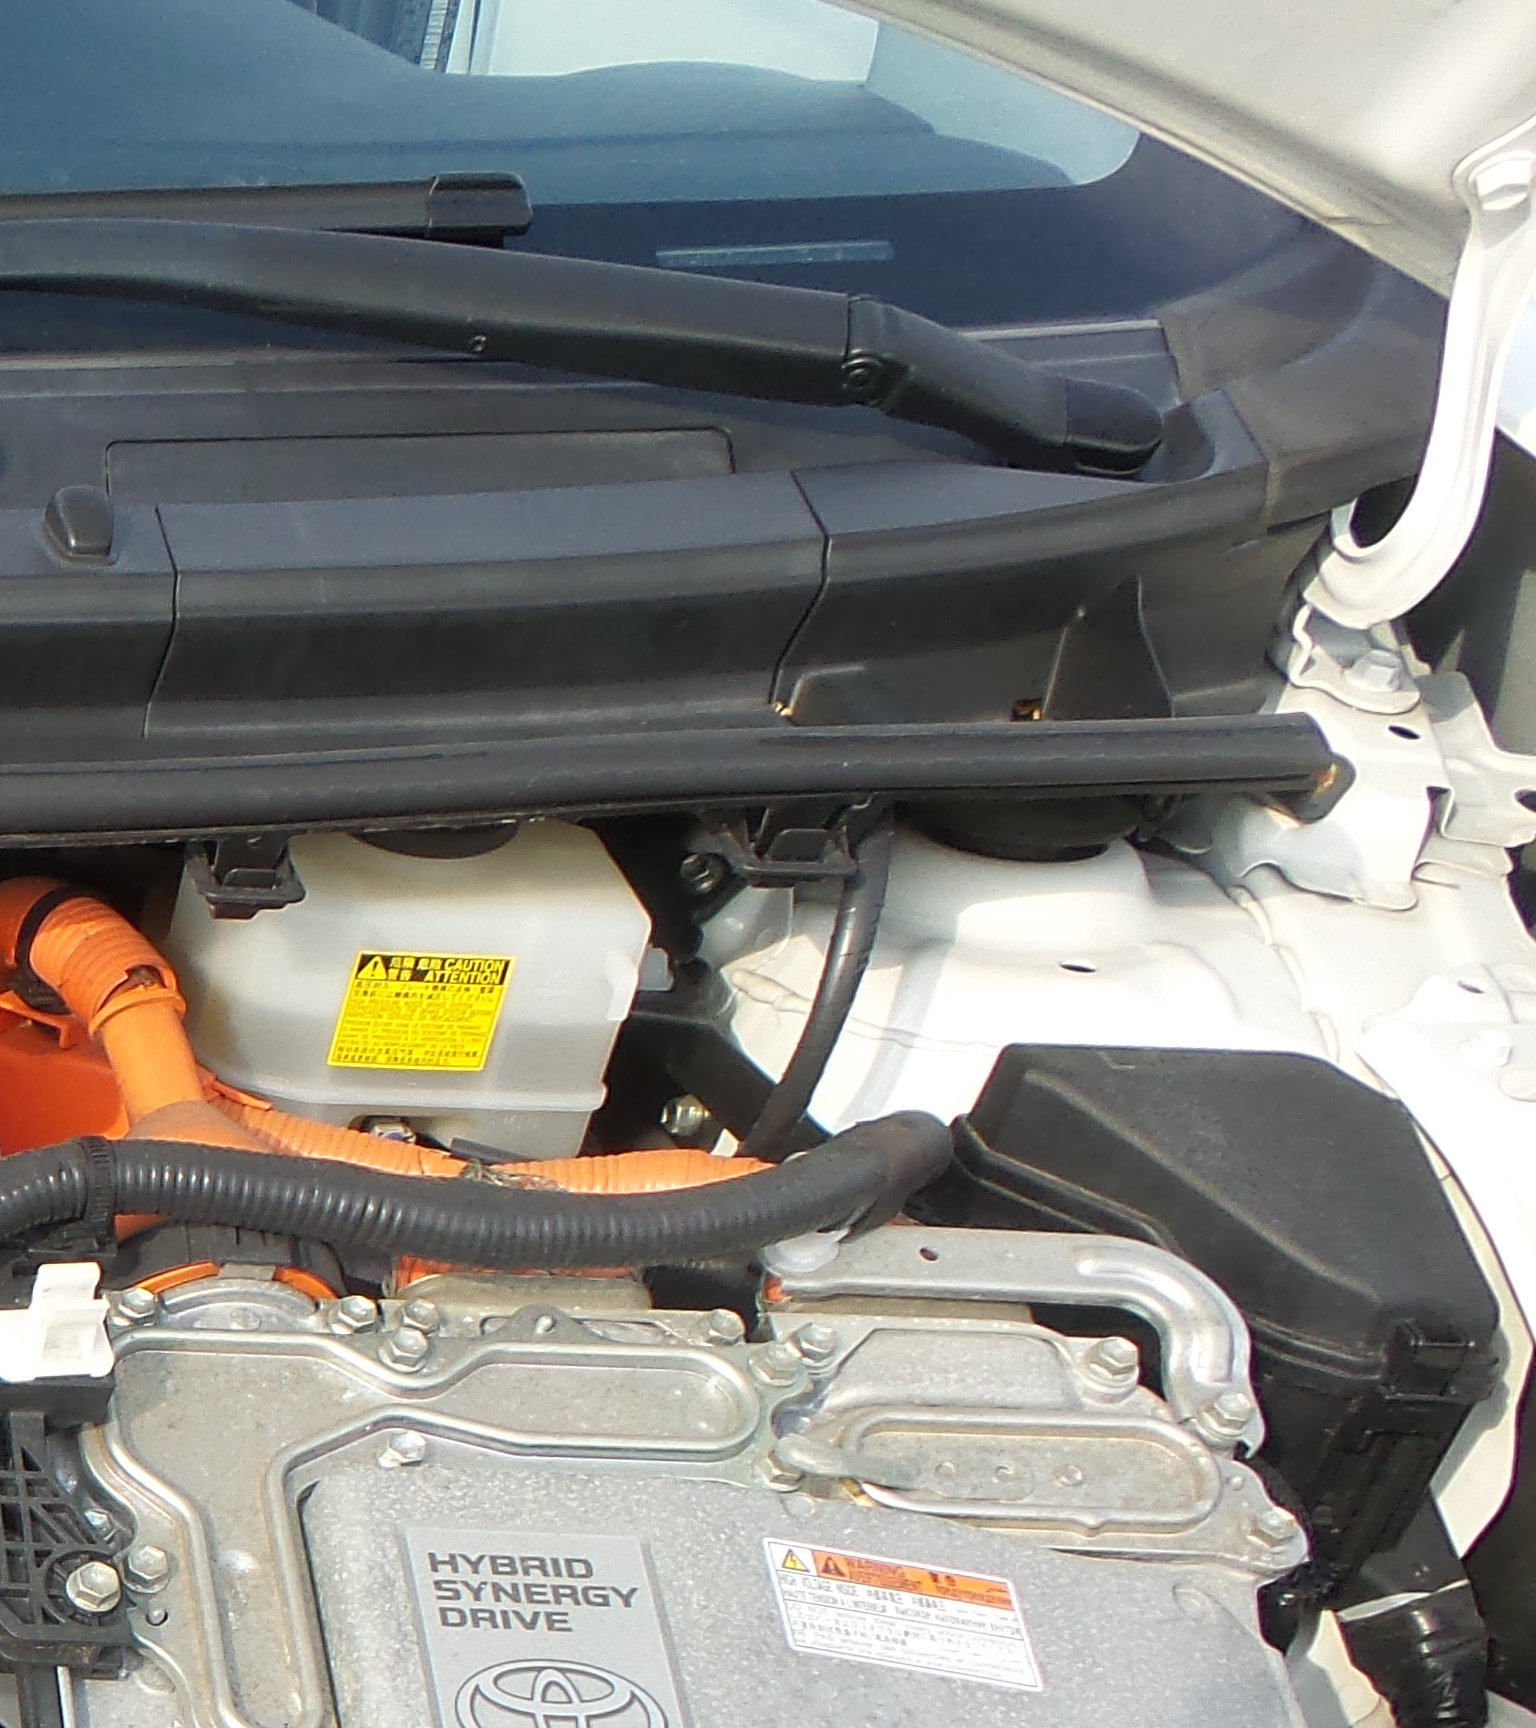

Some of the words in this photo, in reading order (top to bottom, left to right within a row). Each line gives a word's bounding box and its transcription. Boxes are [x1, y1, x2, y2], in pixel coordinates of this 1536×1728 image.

[423, 970, 502, 984] ATTENTION
[443, 959, 505, 973] CAUTION
[427, 1551, 594, 1579] HYBRID
[432, 1579, 639, 1608] SYNERGY
[438, 1605, 573, 1632] DRIVE
